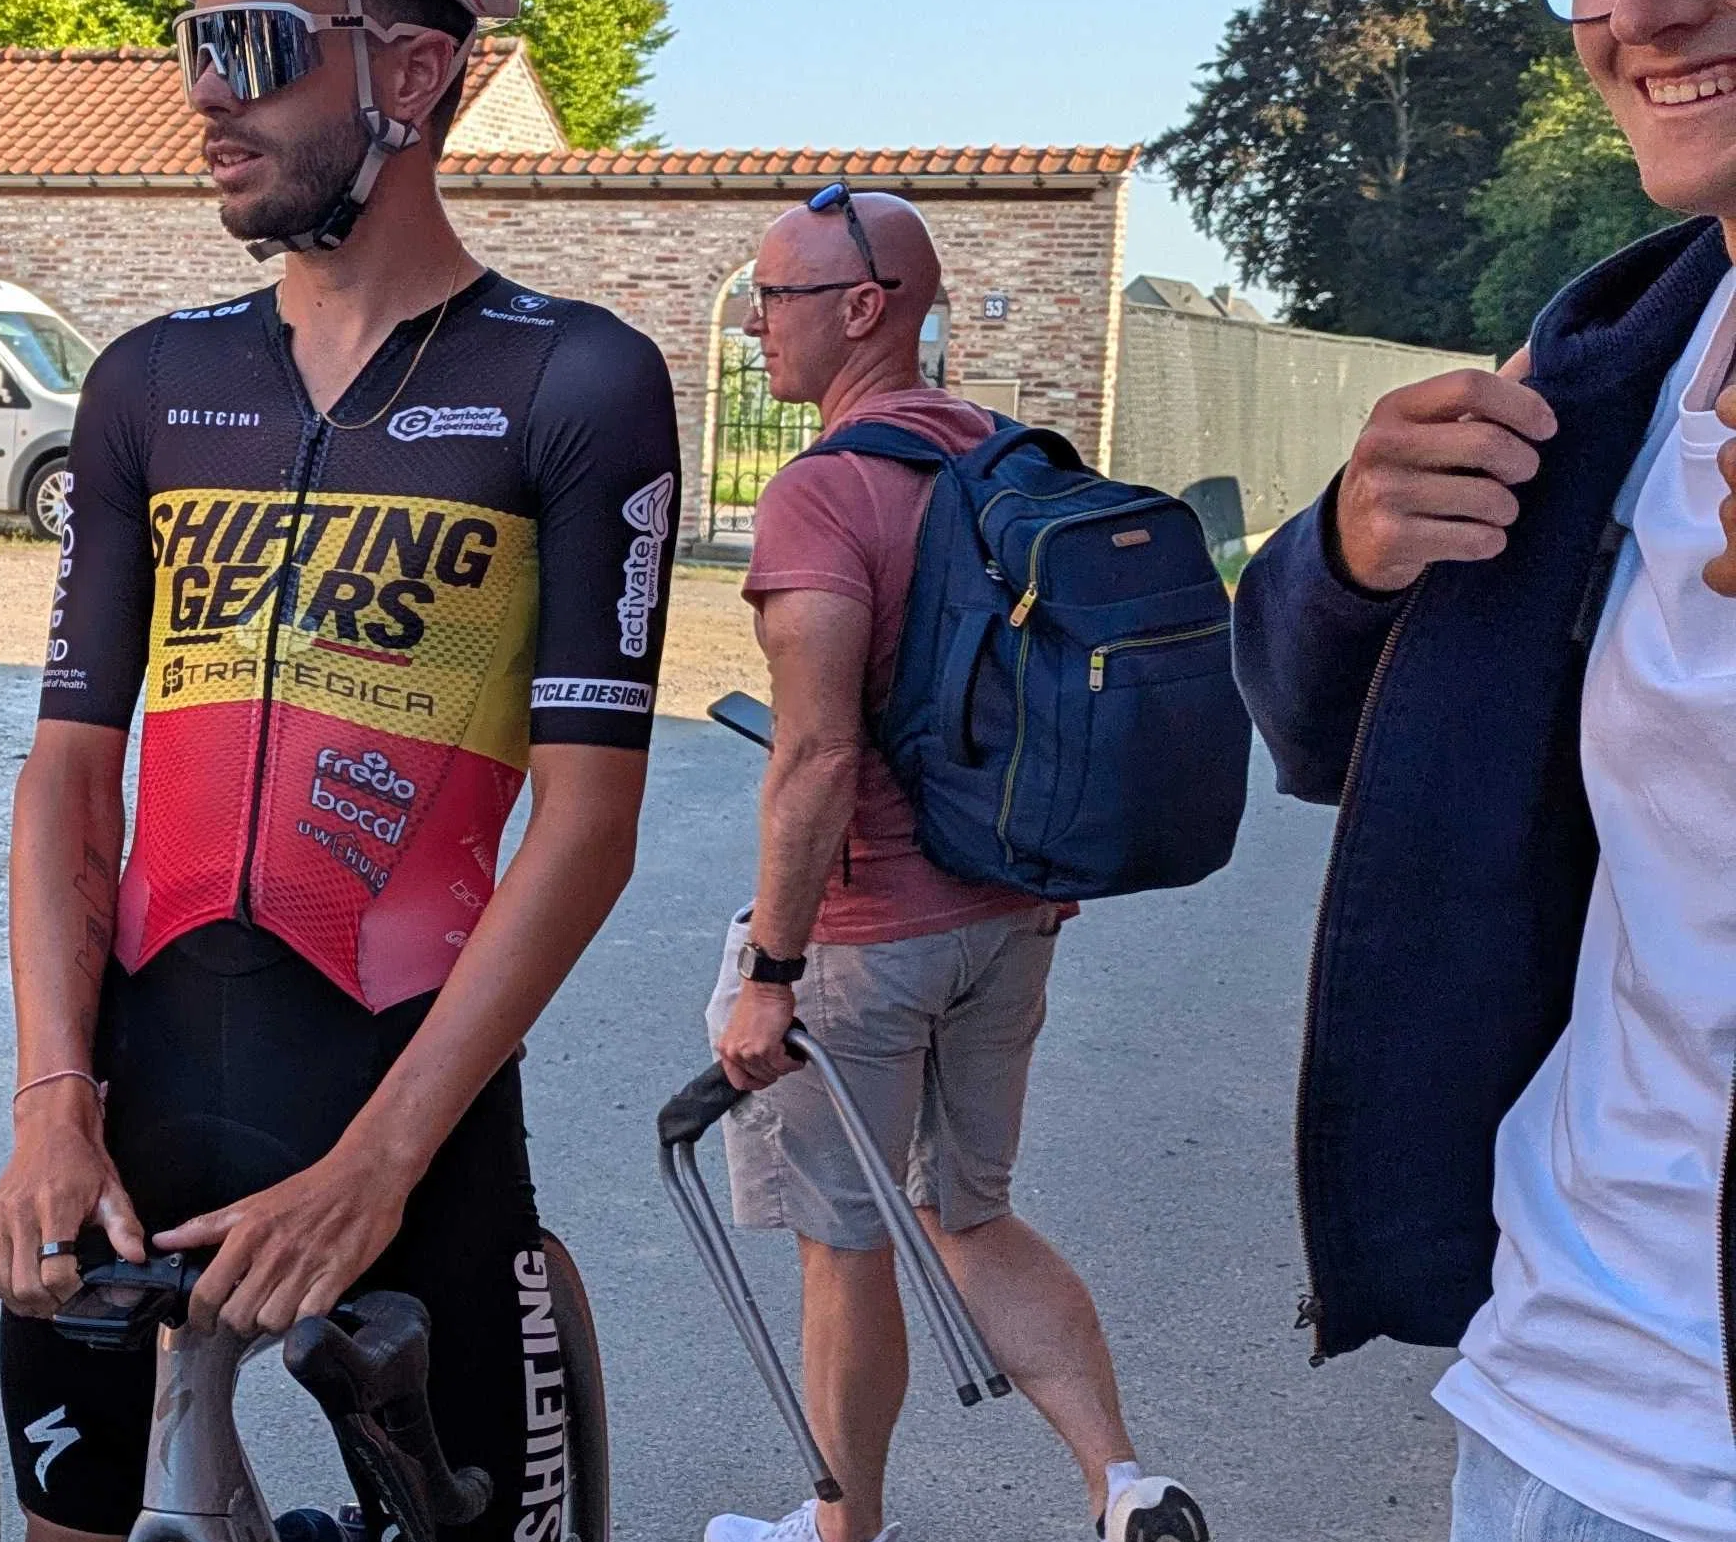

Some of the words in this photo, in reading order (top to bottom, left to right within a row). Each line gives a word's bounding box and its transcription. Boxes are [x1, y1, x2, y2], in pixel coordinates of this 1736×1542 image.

[169, 301, 252, 320] NAOS
[985, 299, 1003, 317] 53
[167, 409, 260, 427] DOLTCINI
[437, 410, 495, 422] kantoor
[151, 500, 499, 590] SHIFTING
[169, 562, 436, 650] GEARS
[622, 540, 652, 654] activate
[311, 778, 407, 845] bocal
